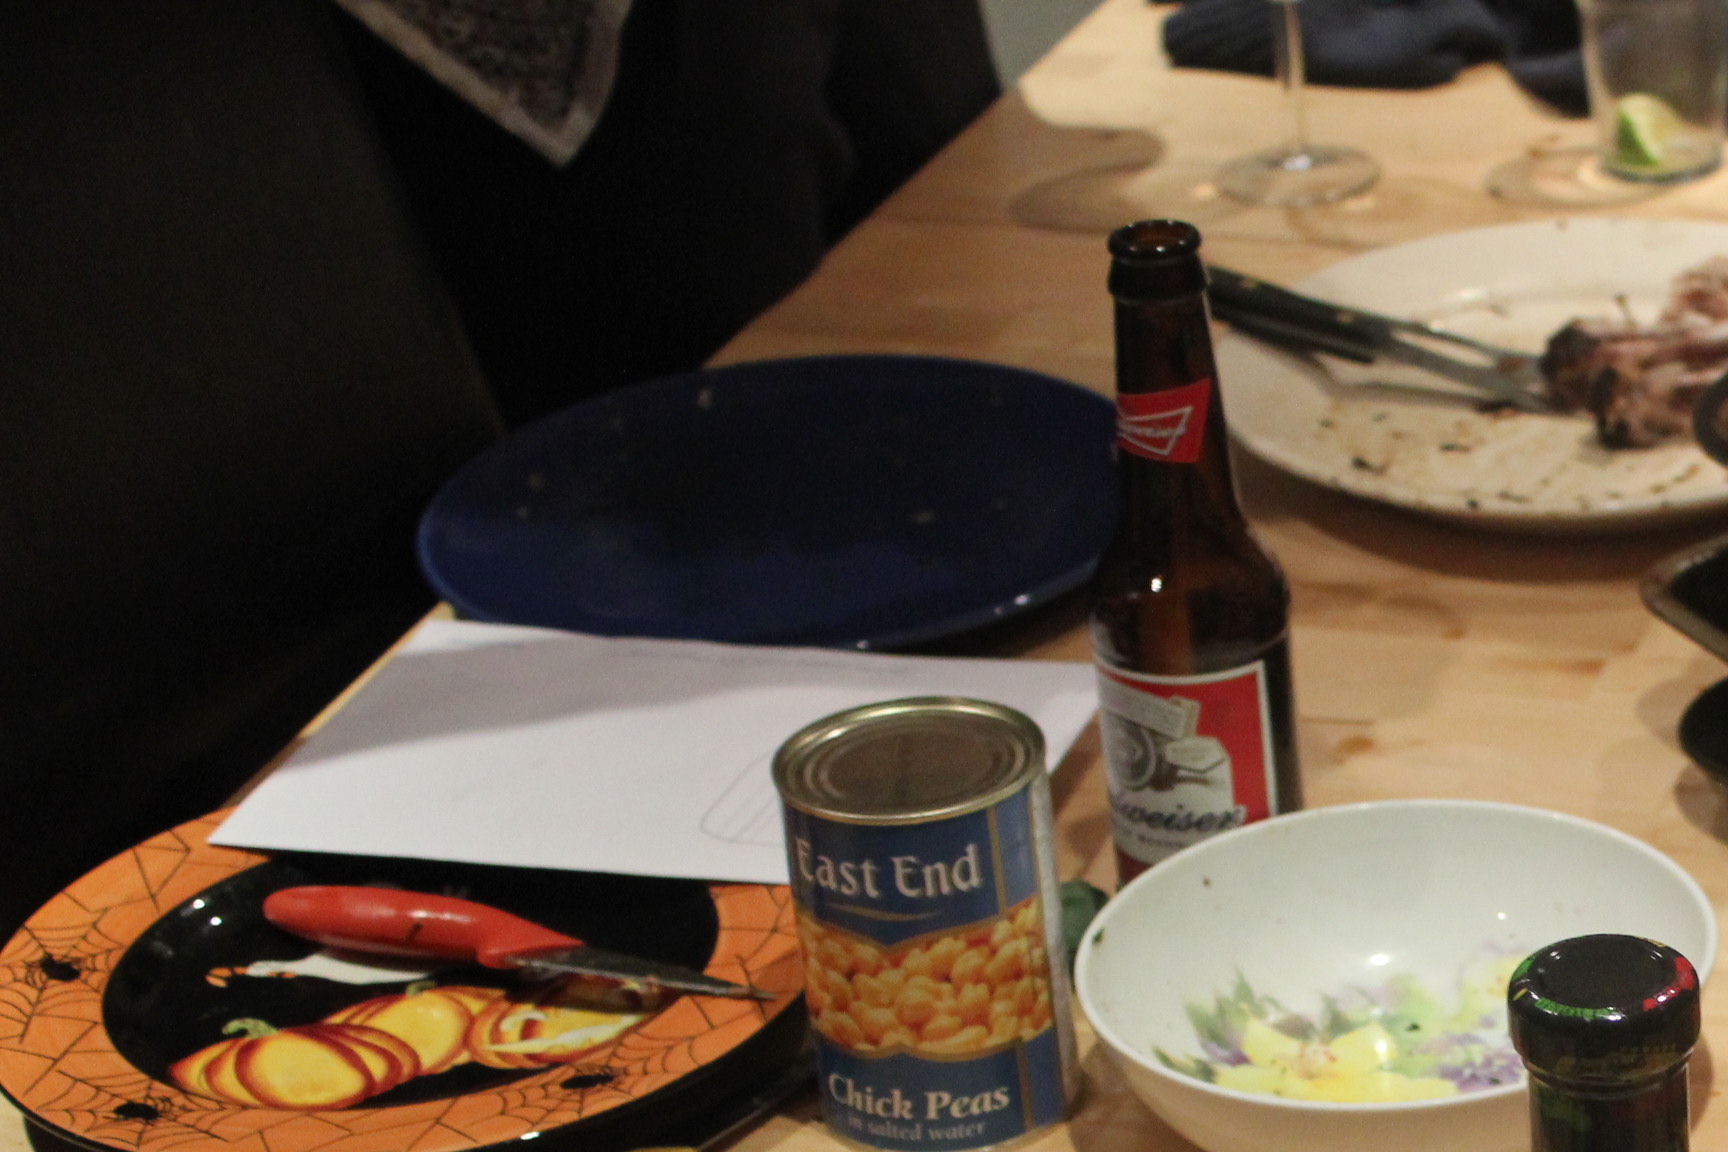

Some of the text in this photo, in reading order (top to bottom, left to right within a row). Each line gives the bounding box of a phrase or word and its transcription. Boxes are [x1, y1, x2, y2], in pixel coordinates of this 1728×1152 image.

[795, 836, 983, 899] East End
[828, 1073, 1011, 1121] Chick Peas
[867, 1120, 923, 1141] salted
[928, 1121, 986, 1141] water
